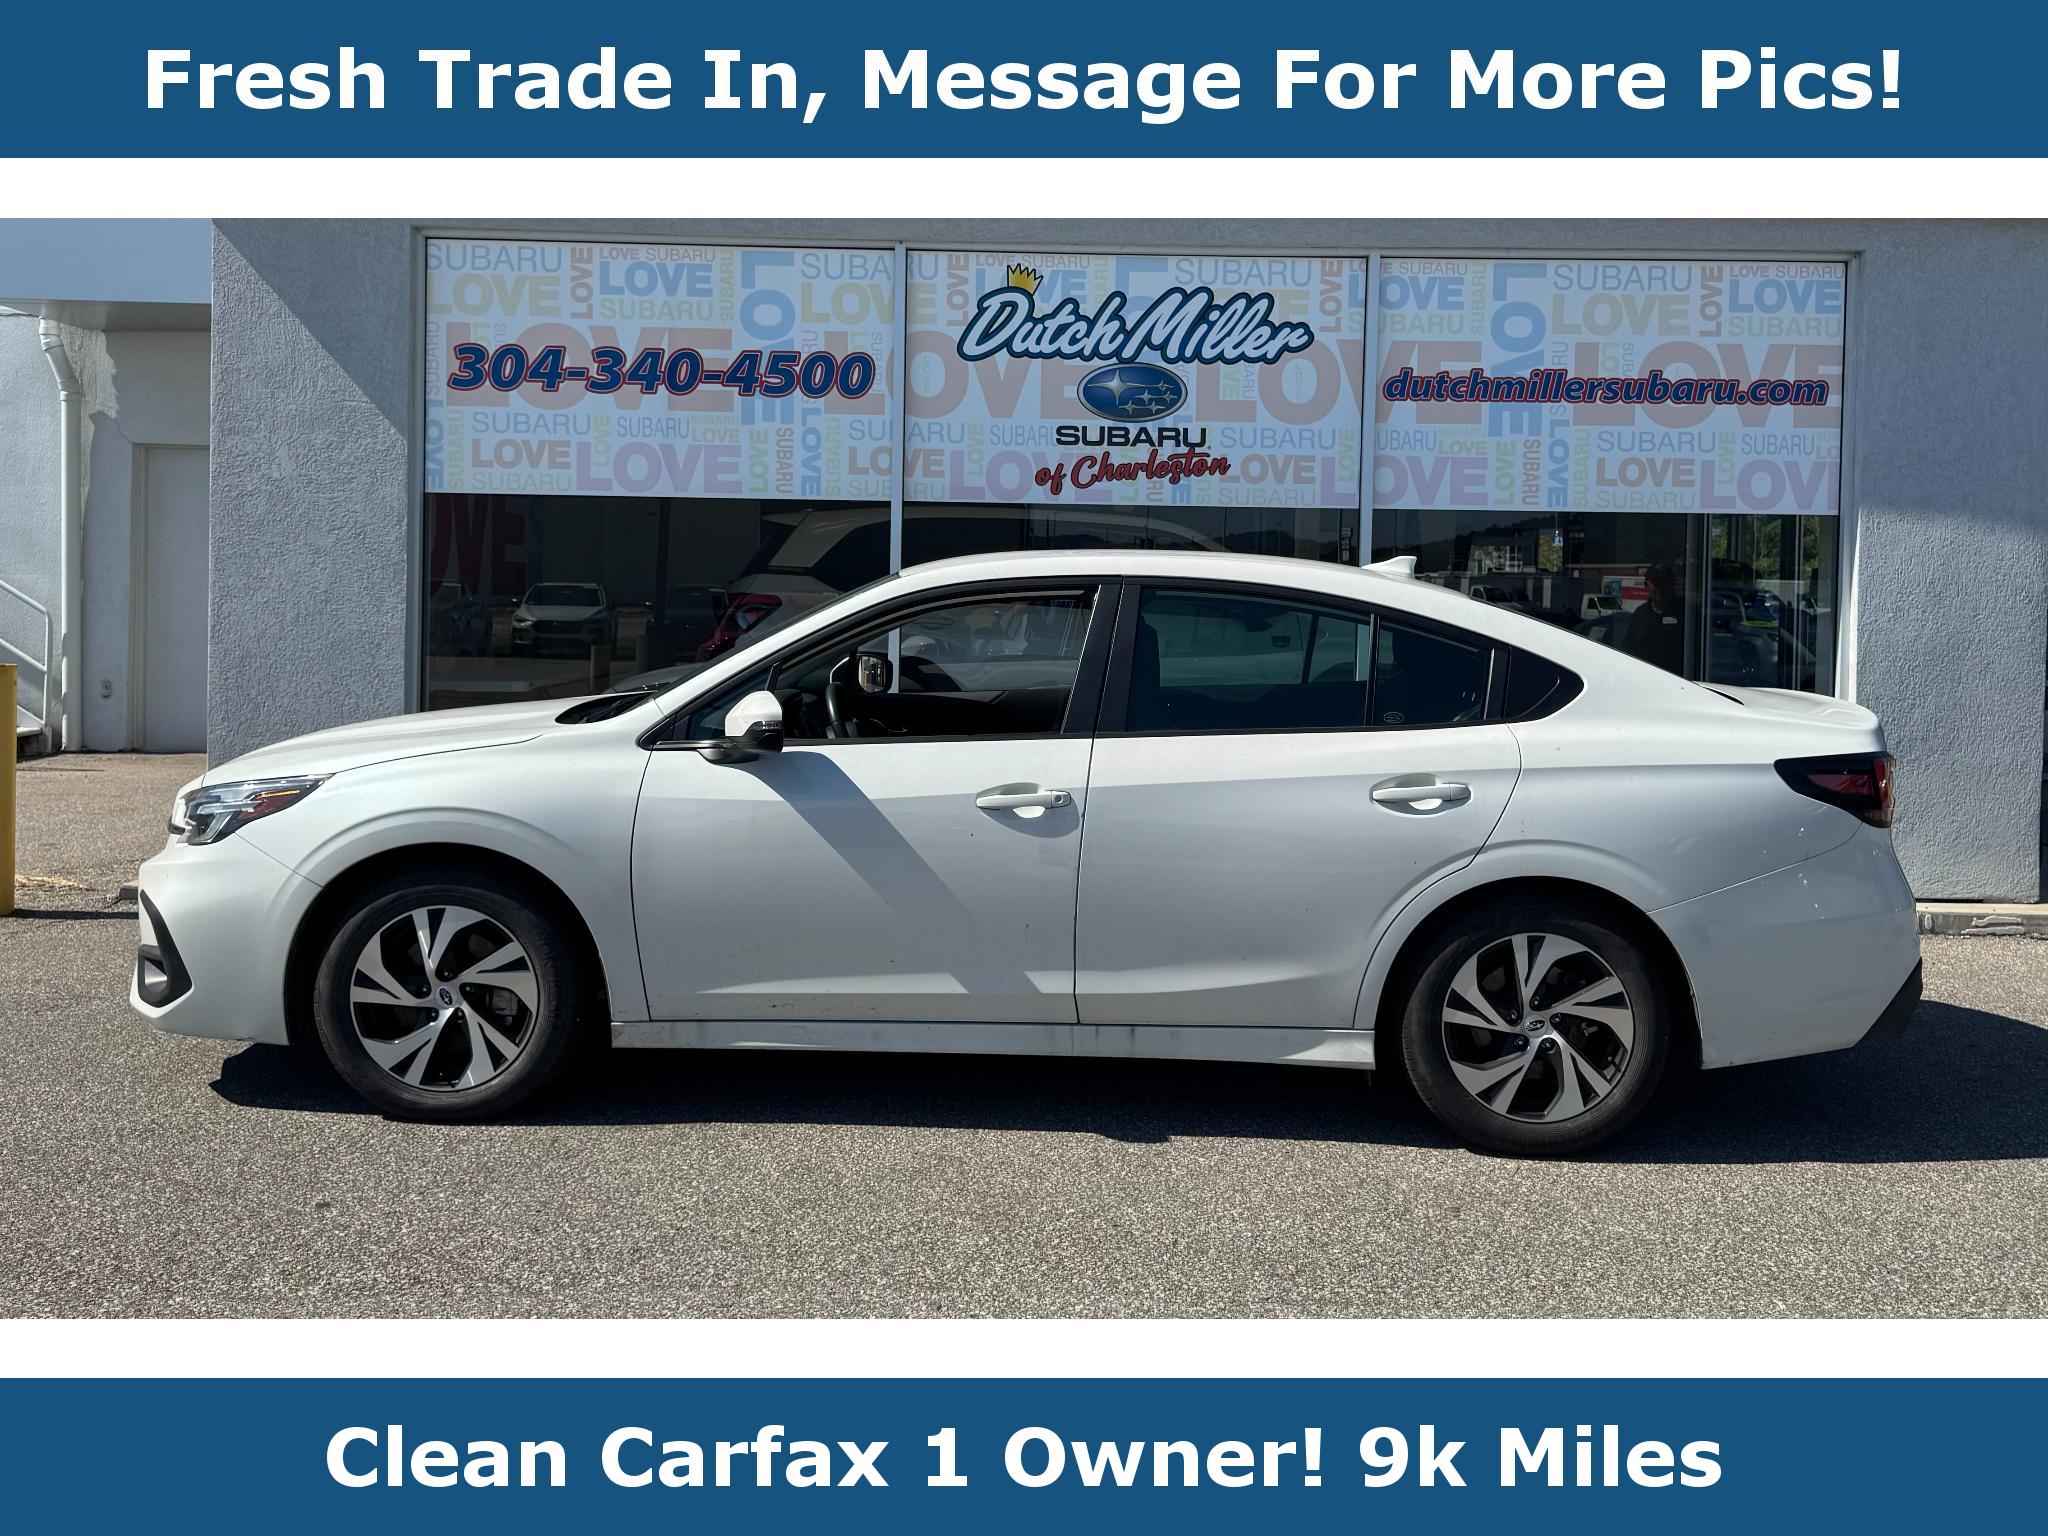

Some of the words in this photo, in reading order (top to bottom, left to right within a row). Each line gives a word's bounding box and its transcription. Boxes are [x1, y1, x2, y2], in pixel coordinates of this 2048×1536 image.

[427, 243, 562, 272] SUBARU
[600, 247, 639, 260] LOVE
[646, 248, 716, 262] SUBARU
[976, 254, 1015, 268] LOVE
[1020, 255, 1090, 269] SUBARU
[1175, 259, 1312, 287] SUBARU
[1399, 262, 1468, 276] SUBARU
[1730, 265, 1770, 278] LOVE
[1775, 266, 1844, 279] SUBARU
[427, 272, 561, 317] LOVE
[570, 247, 593, 319] LOVE
[600, 261, 713, 297] LOVE
[720, 250, 735, 323] SUBARU
[947, 254, 969, 327] LOVE
[1319, 260, 1343, 333] LOVE
[1553, 264, 1692, 292] SUBARU
[1729, 279, 1842, 315] LOVE
[600, 298, 713, 322] SUBARU
[1471, 263, 1487, 335] SUBARU
[1551, 293, 1690, 336] LOVE
[1700, 265, 1723, 337] LOVE
[957, 286, 1130, 362] Dutch
[1115, 286, 1314, 365] Miller
[1728, 315, 1841, 337] SUBARU
[447, 342, 876, 399] 304-340-4500
[1383, 366, 1829, 406] dutchmillersubaru.com
[472, 411, 591, 435] SUBARU
[592, 413, 611, 468] LOVE
[617, 415, 689, 439] SUBARU
[691, 427, 740, 443] LOVE
[1056, 425, 1207, 448] SUBARU
[1220, 427, 1336, 450] SUBARU
[1374, 430, 1437, 452] UBARU
[1597, 430, 1716, 453] SUBARU
[450, 409, 465, 489] SUBARU
[472, 438, 571, 469] LOVE
[748, 427, 769, 494] LOVE
[776, 427, 794, 494] SUBARU
[801, 407, 822, 496] LOVE
[825, 417, 842, 497] SUBARU
[966, 421, 984, 477] LOVE
[1338, 429, 1356, 483] LOVE
[1438, 440, 1487, 456] LOVE
[1547, 419, 1570, 508] LOVE
[1718, 431, 1736, 485] LOVE
[1741, 432, 1815, 456] SUBARU
[472, 473, 571, 491] SUBARU
[576, 440, 742, 494] LOVE
[1035, 463, 1067, 495] of
[1071, 448, 1231, 489] Charleston
[1495, 442, 1516, 505] LOVE
[1521, 438, 1541, 506] SUBARU
[1572, 429, 1591, 508] SUBARU
[1595, 457, 1695, 488] LOVE
[1218, 487, 1316, 507] SUBARU
[1595, 490, 1696, 510] SUBARU
